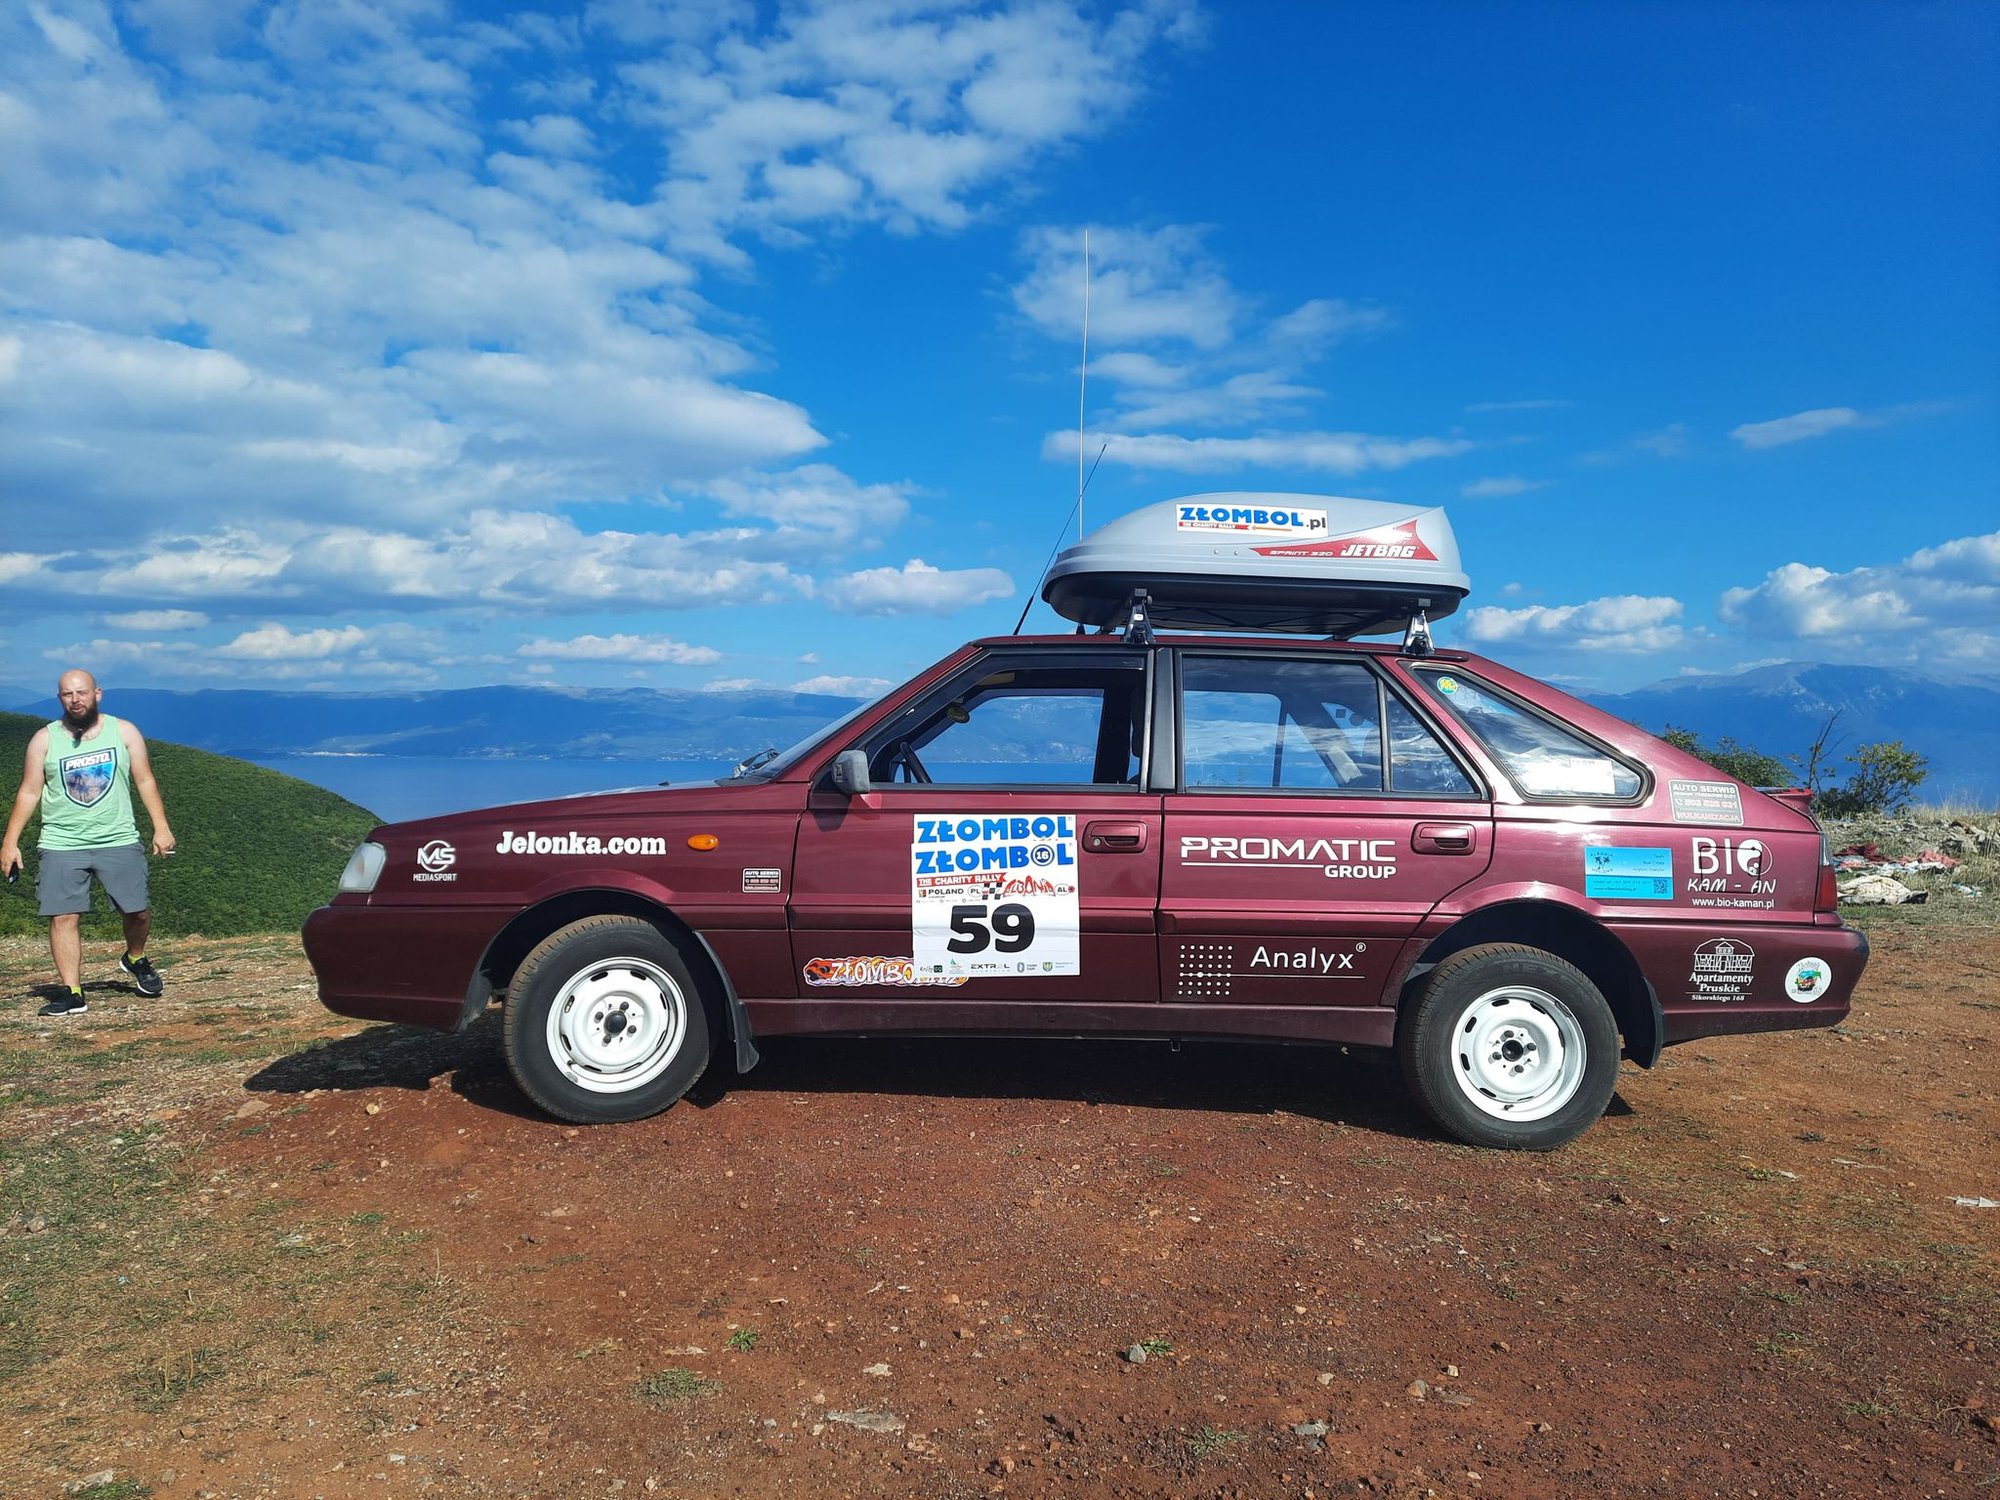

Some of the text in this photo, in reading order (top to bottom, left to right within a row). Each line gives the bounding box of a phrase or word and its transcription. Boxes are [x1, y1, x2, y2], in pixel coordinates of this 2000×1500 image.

[1340, 544, 1417, 558] JETBAG
[1672, 783, 1736, 794] AUTO SERWIS
[917, 816, 1074, 844] ZŁOMBOL
[496, 831, 667, 855] Jelonka.com
[1180, 836, 1397, 862] PROMATIC
[412, 873, 458, 882] MEDIASPORT
[1324, 864, 1397, 879] GROUP
[918, 873, 1002, 887] THE CHARITY RALLY
[1687, 878, 1727, 893] KAM
[1750, 879, 1777, 894] AN
[1692, 897, 1775, 910] www.bio-kaman.pl
[946, 902, 1036, 954] 59
[1689, 972, 1754, 986] Apartamenty
[1699, 983, 1741, 993] Pruskie
[1691, 994, 1731, 1003] Sikorskiego
